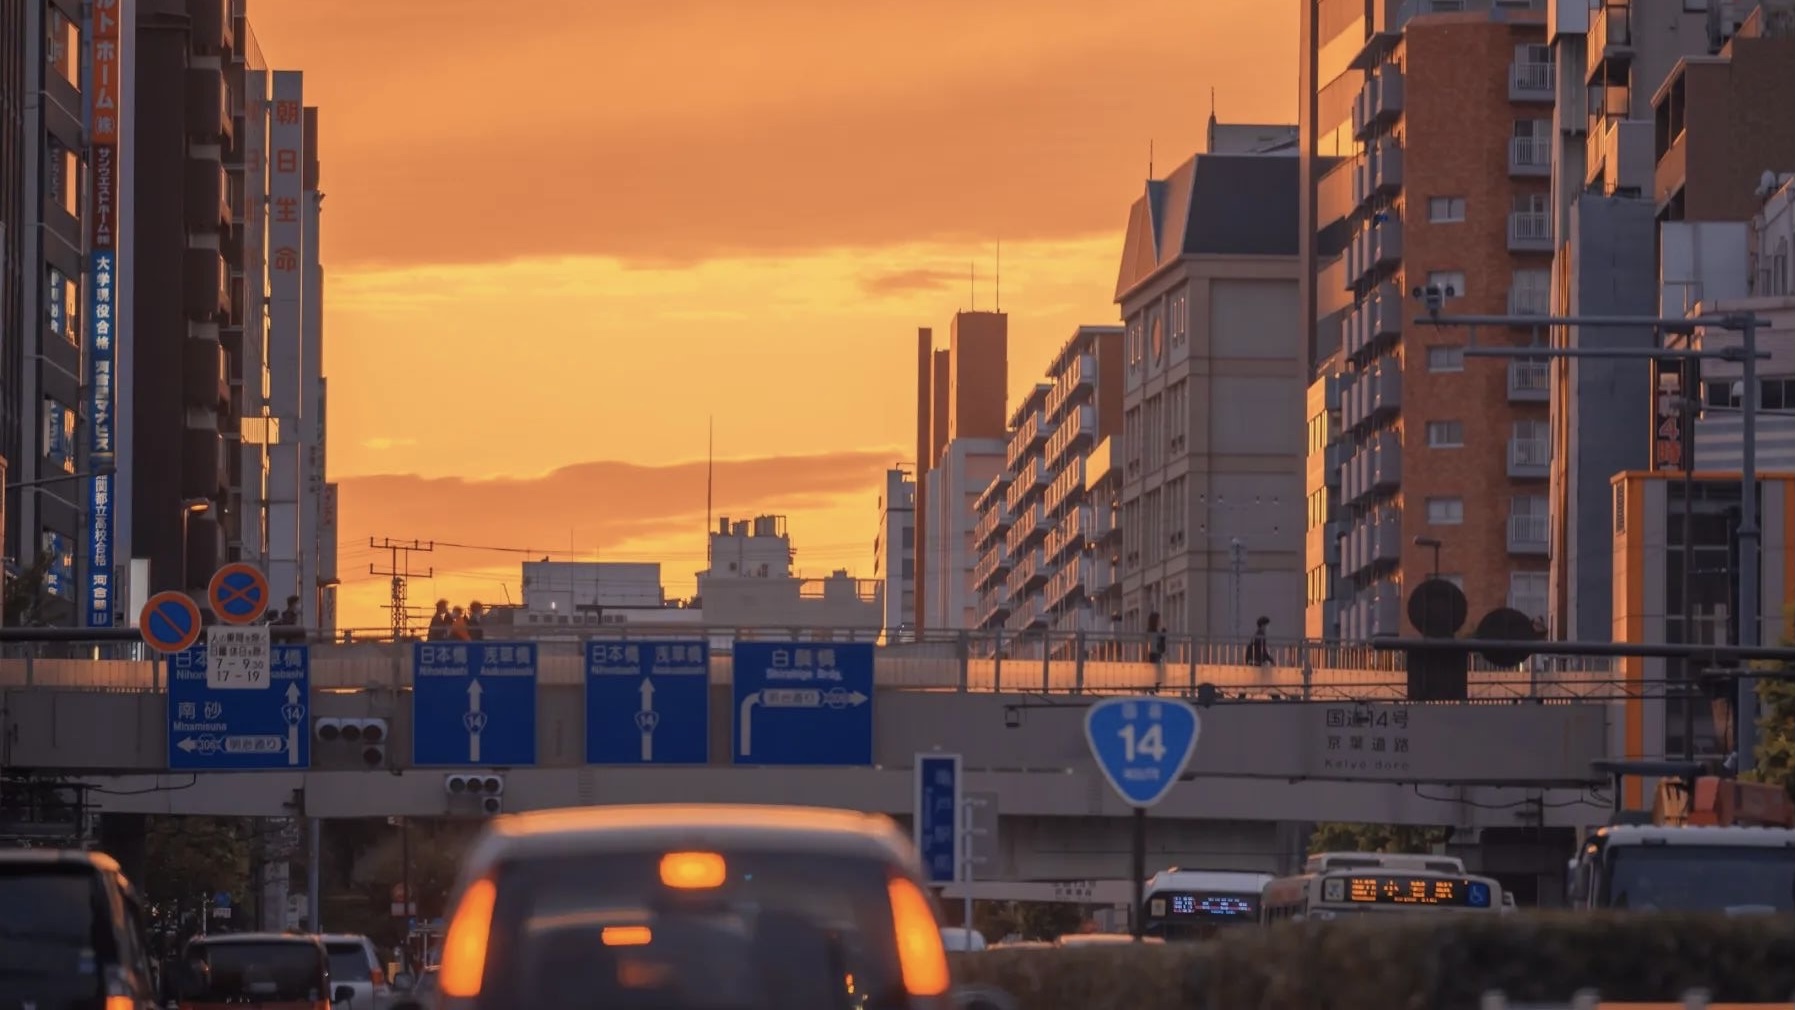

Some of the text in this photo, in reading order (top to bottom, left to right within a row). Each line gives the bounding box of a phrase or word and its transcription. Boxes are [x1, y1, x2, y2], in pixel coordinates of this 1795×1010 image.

[275, 101, 298, 272] 朝日生命
[96, 256, 110, 350] 大学現役合格
[421, 646, 467, 664] 日本橋
[592, 645, 640, 664] 日本橋
[216, 658, 223, 669] 7
[176, 670, 207, 680] Nihon
[217, 671, 229, 682] 17
[247, 671, 260, 682] 19
[178, 702, 222, 719] 南砂
[286, 709, 300, 719] 14
[173, 722, 228, 732] Minamisuna
[467, 716, 482, 727] 14
[639, 716, 654, 727] 14
[1117, 723, 1167, 762] 14
[1327, 736, 1409, 752] 京葉道路
